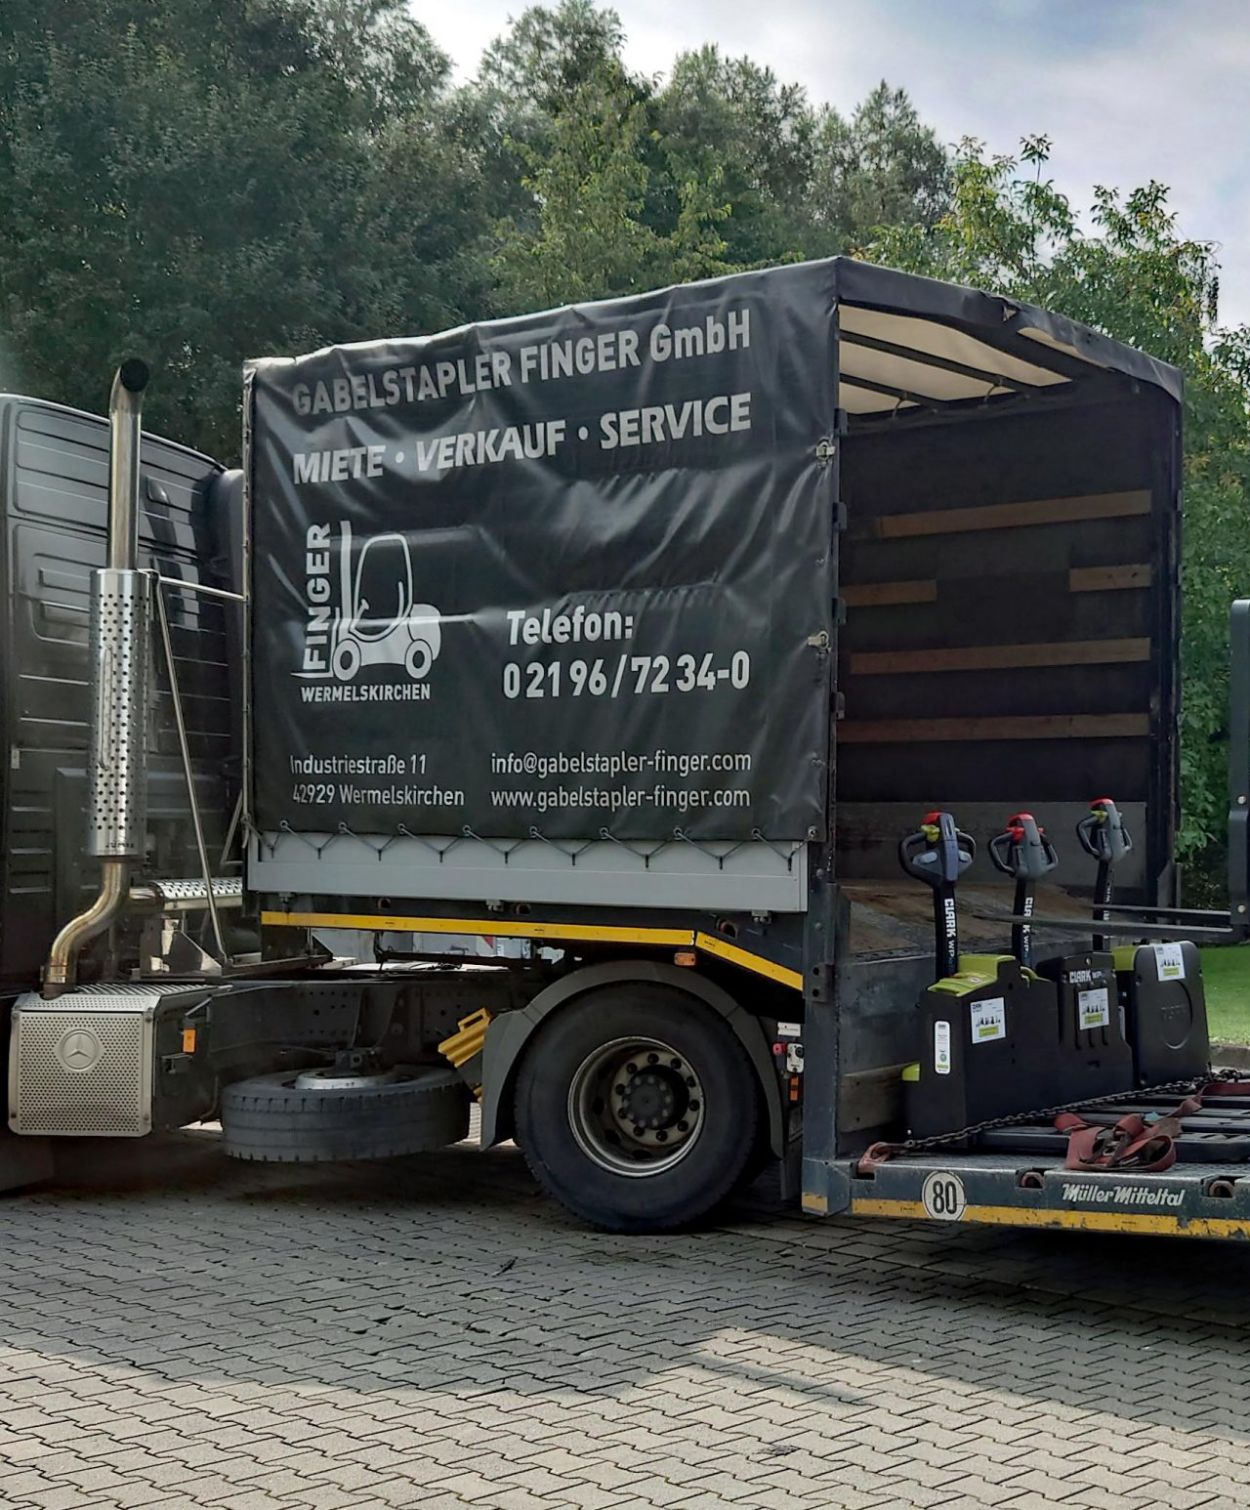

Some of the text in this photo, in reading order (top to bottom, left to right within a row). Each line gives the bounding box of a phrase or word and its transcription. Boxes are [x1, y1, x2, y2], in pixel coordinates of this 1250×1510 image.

[293, 308, 750, 415] GABELSTAPLER FINGER GmbH
[293, 392, 751, 484] MIETE VERKAUF SERVICE
[302, 523, 331, 671] FINGER
[507, 605, 634, 645] Telefon:
[301, 683, 431, 702] WERMELSKIRCHEN
[289, 754, 426, 774] Industriestraße 11
[491, 750, 751, 778] info@gabelstapler-finger.com
[293, 784, 465, 806] 42929 Wermelskirchen
[491, 785, 751, 812] www.gabelstapler-finger.com
[944, 898, 956, 937] CLARK
[1022, 897, 1034, 933] CLAK
[933, 1180, 957, 1214] 80
[1062, 1183, 1185, 1206] Müller Mitteltal
